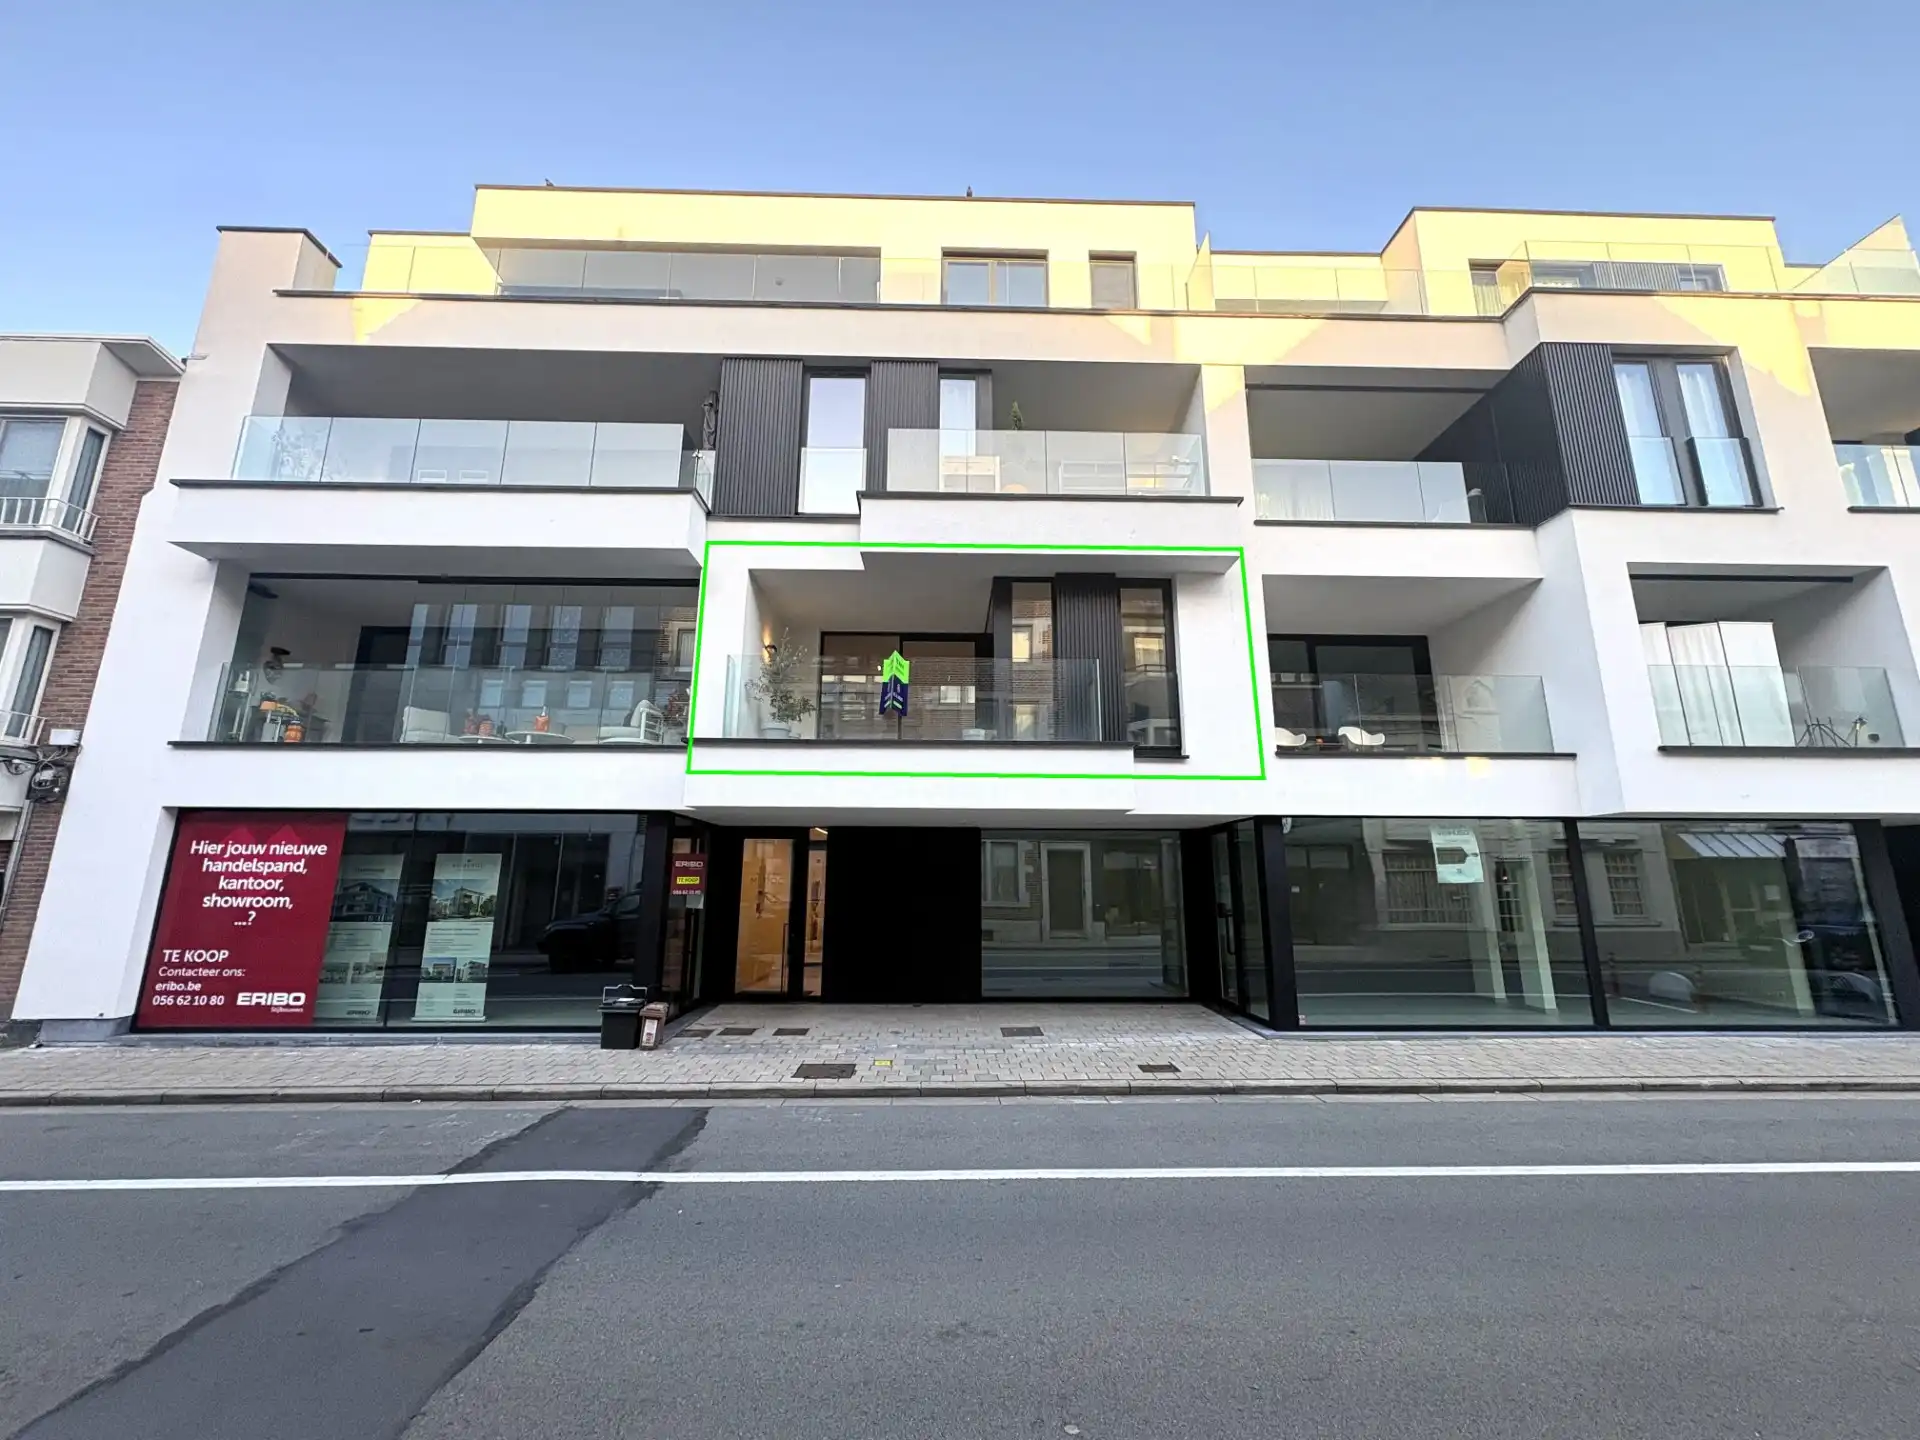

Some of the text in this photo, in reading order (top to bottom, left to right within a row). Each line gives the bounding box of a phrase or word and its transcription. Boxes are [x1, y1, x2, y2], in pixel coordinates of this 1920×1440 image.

[190, 840, 327, 858] Hier jouw nieuwe
[202, 858, 308, 876] handelspand,
[675, 860, 704, 868] ERIBO
[218, 875, 284, 892] kantoor,
[202, 893, 294, 910] showroom,
[163, 949, 229, 963] TE KOOP
[158, 966, 246, 977] Contacteer ons:
[155, 981, 202, 991] eribo.be
[152, 995, 225, 1006] 056 62 10 80
[236, 992, 307, 1006] ERIBO
